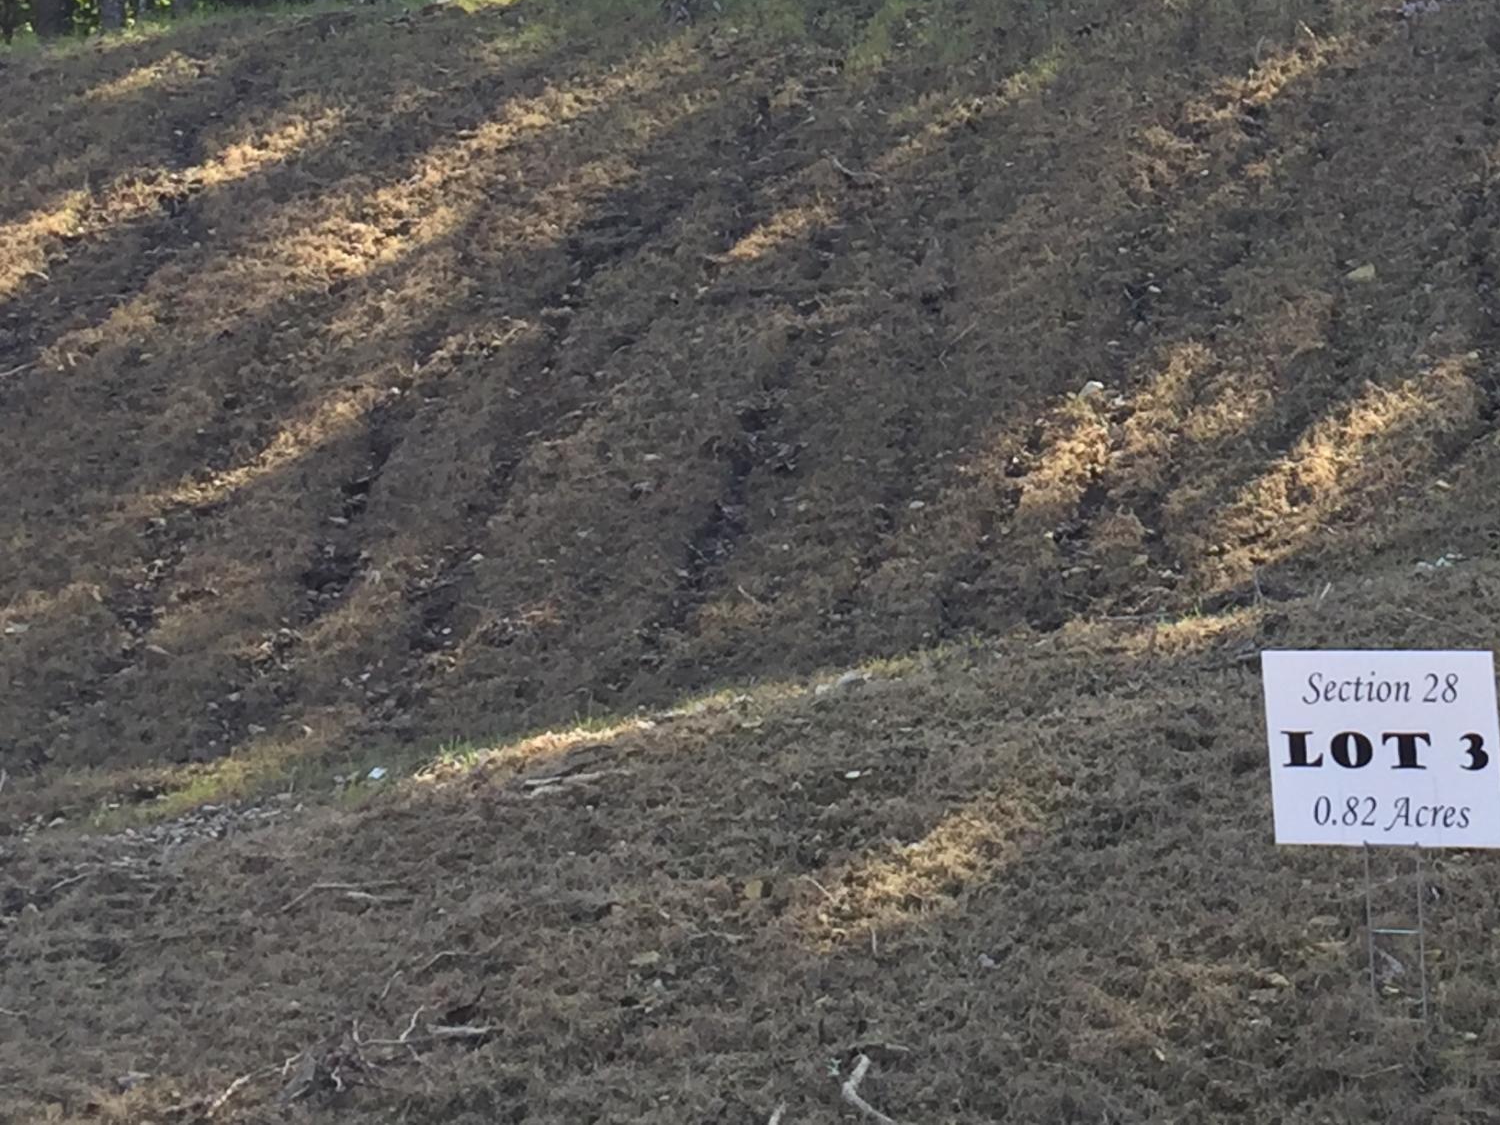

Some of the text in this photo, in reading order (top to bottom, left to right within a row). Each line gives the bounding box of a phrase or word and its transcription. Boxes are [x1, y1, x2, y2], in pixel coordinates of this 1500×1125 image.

[1302, 671, 1459, 705] Section 28
[1280, 730, 1490, 771] LOT 3
[1314, 796, 1471, 832] 0.82 Acres
